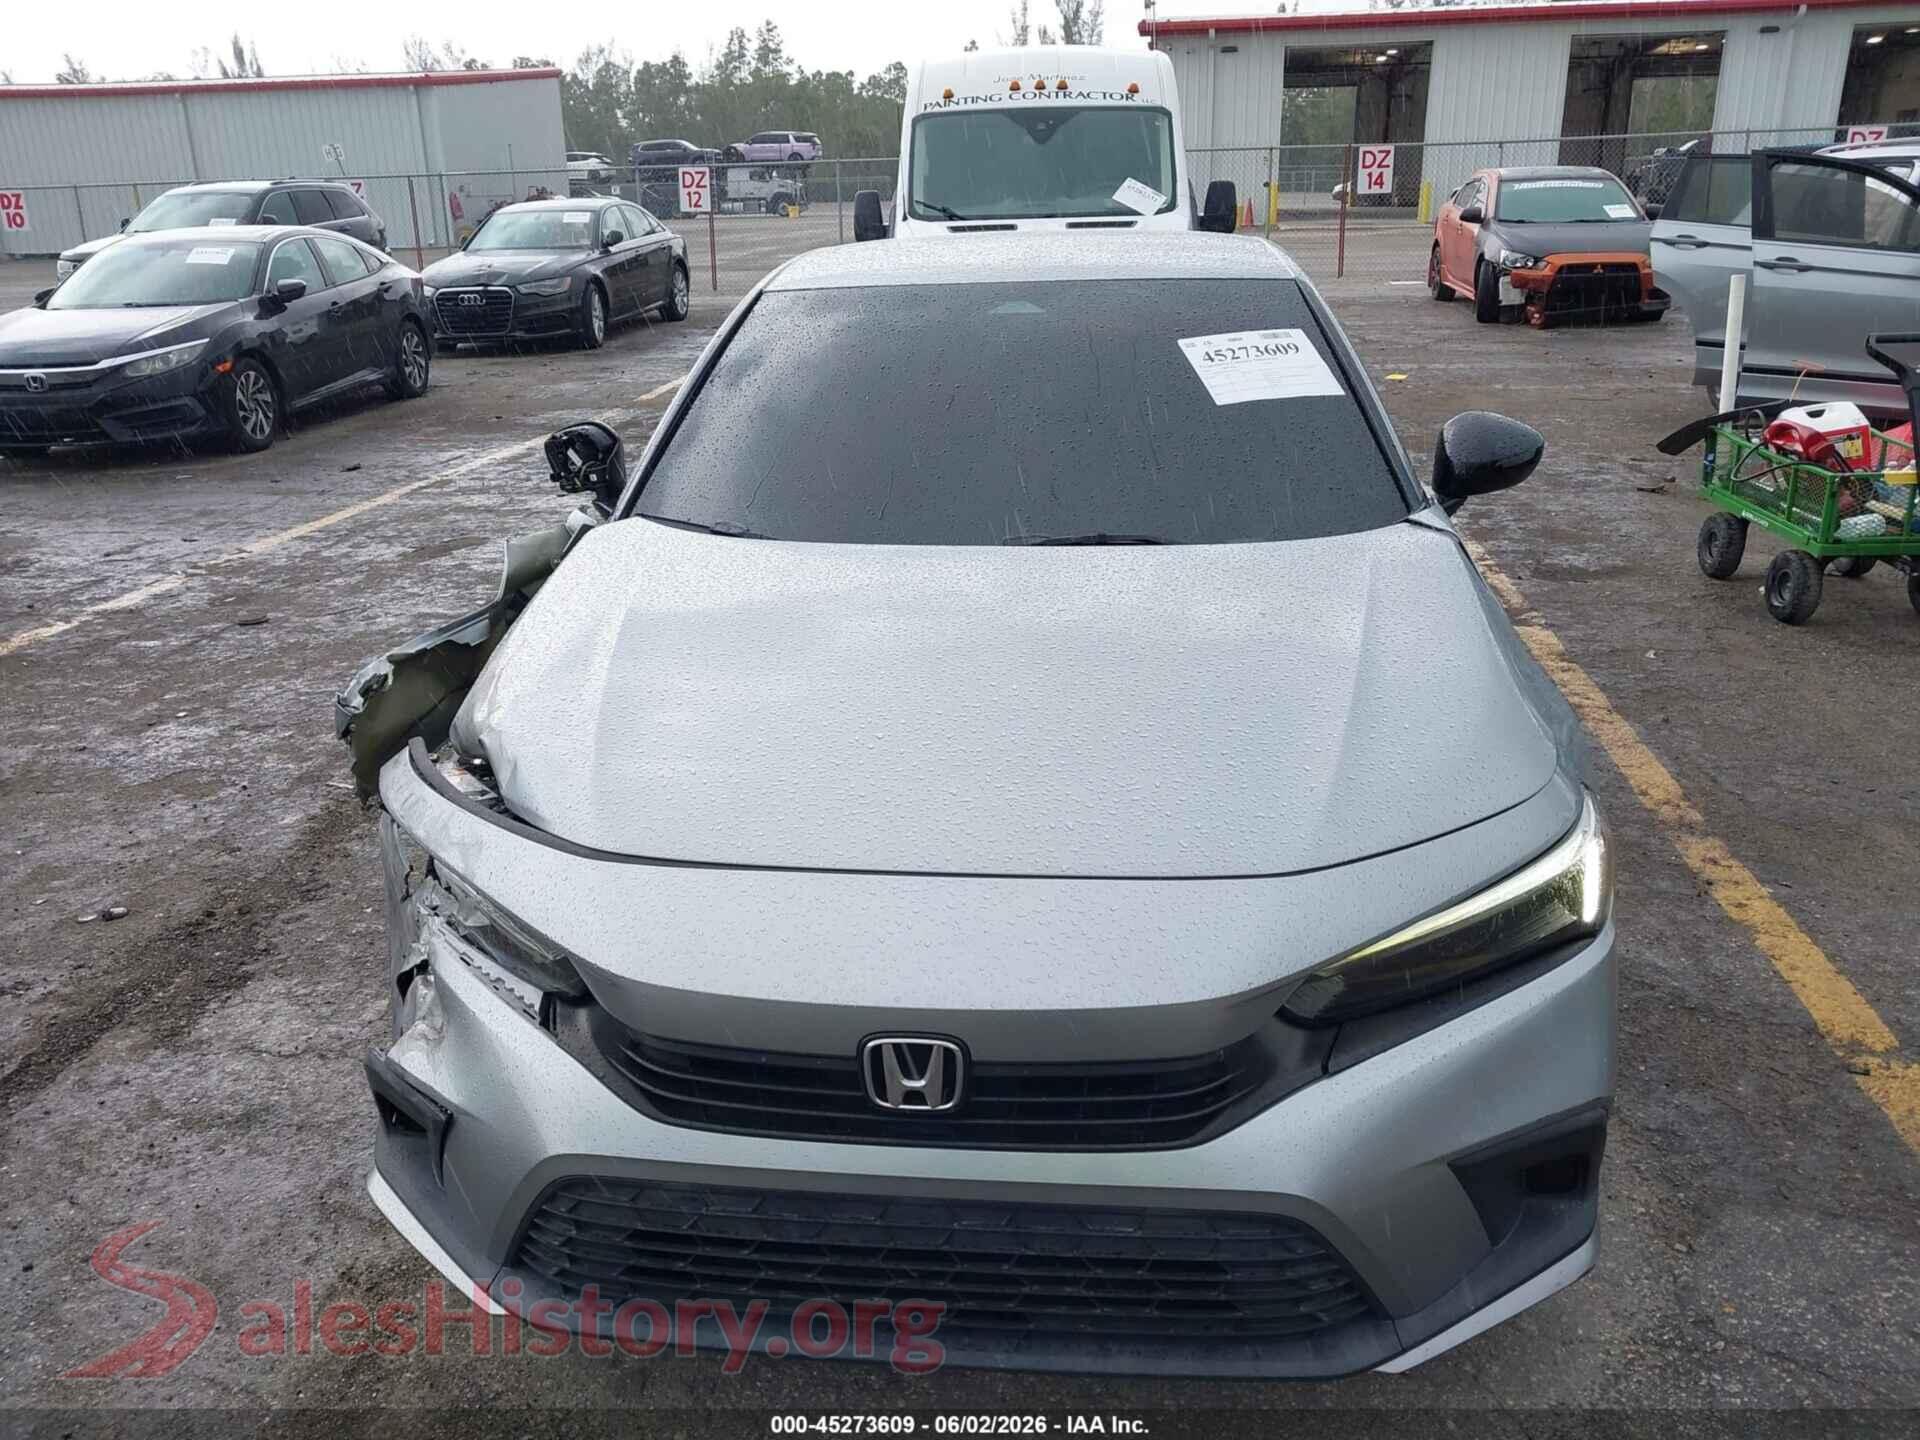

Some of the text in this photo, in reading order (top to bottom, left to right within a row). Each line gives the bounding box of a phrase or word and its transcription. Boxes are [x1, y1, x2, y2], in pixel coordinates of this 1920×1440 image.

[923, 93, 1002, 111] PAINTING
[1008, 90, 1137, 101] CONTRACTOR
[1361, 150, 1391, 169] DZ
[682, 171, 708, 188] DZ
[1367, 171, 1385, 190] 14
[0, 193, 24, 210] DZ
[686, 191, 703, 208] 12
[5, 211, 25, 228] 10
[1202, 342, 1300, 363] 45273609
